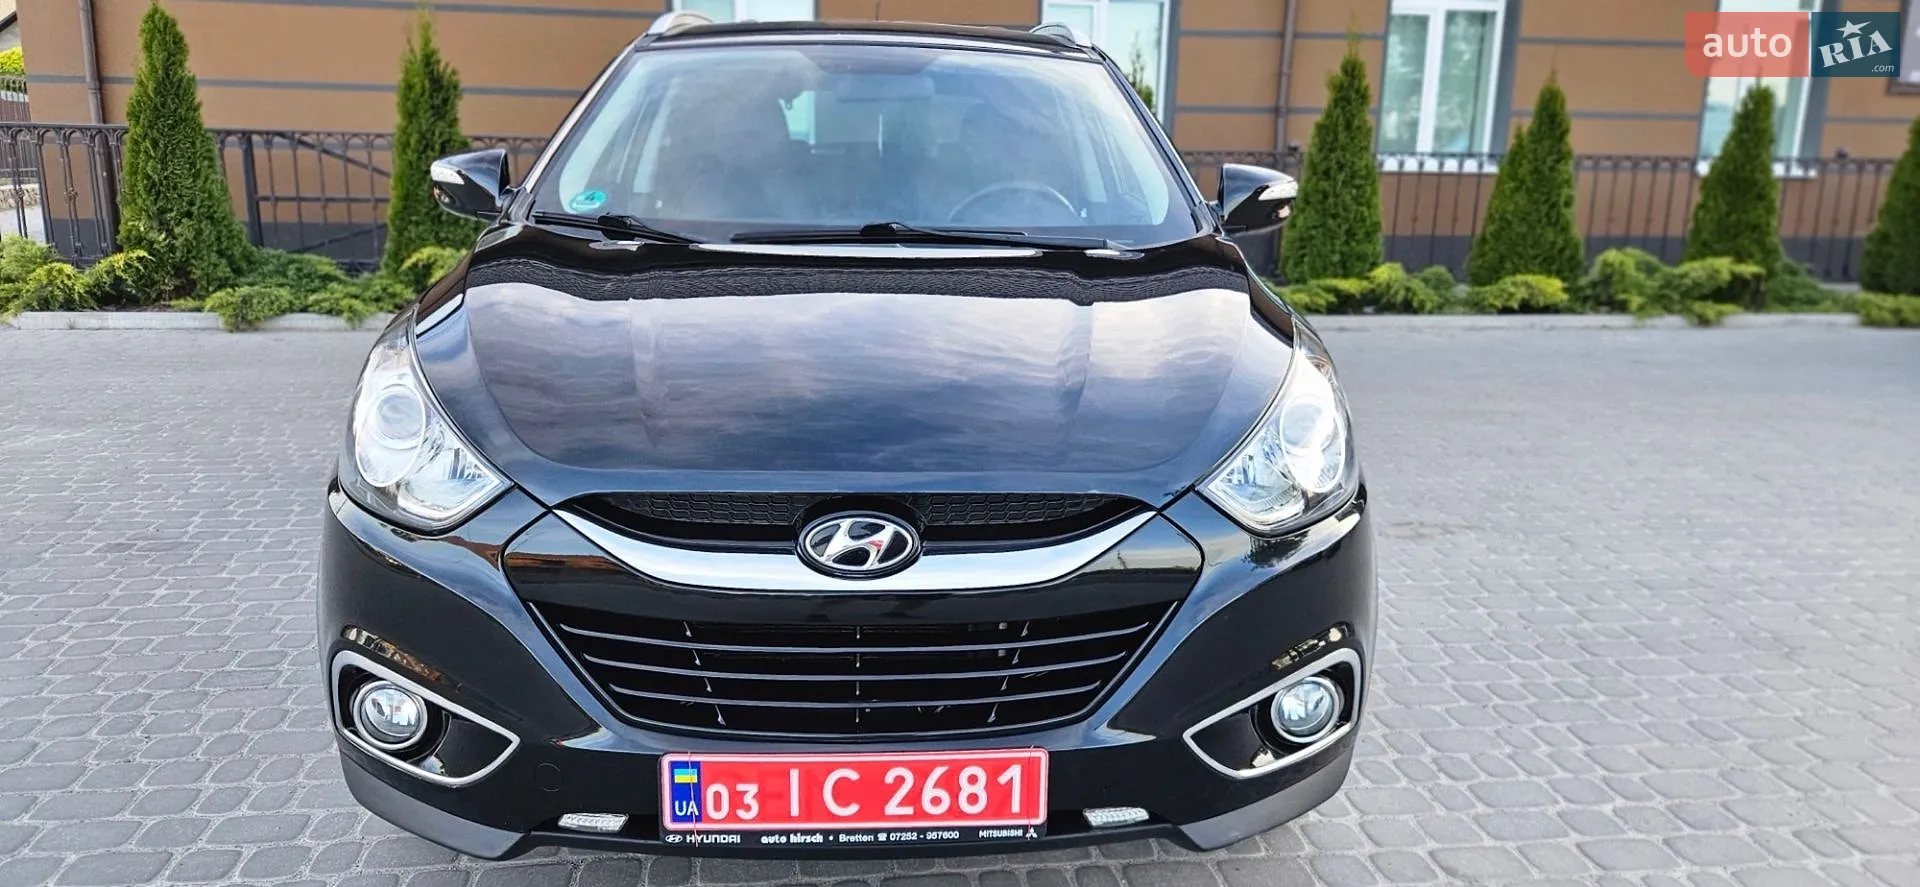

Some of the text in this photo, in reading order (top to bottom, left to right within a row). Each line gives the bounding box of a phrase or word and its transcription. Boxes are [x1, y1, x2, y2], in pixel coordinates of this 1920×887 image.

[705, 783, 760, 820] 03
[884, 764, 1022, 816] 2681
[674, 800, 699, 816] UA
[685, 833, 741, 844] HYUNDAI
[760, 834, 787, 844] auto
[789, 832, 824, 843] hirsch
[838, 832, 874, 843] Bretten
[889, 830, 918, 841] 07252
[978, 828, 1023, 838] MITSUBISHI
